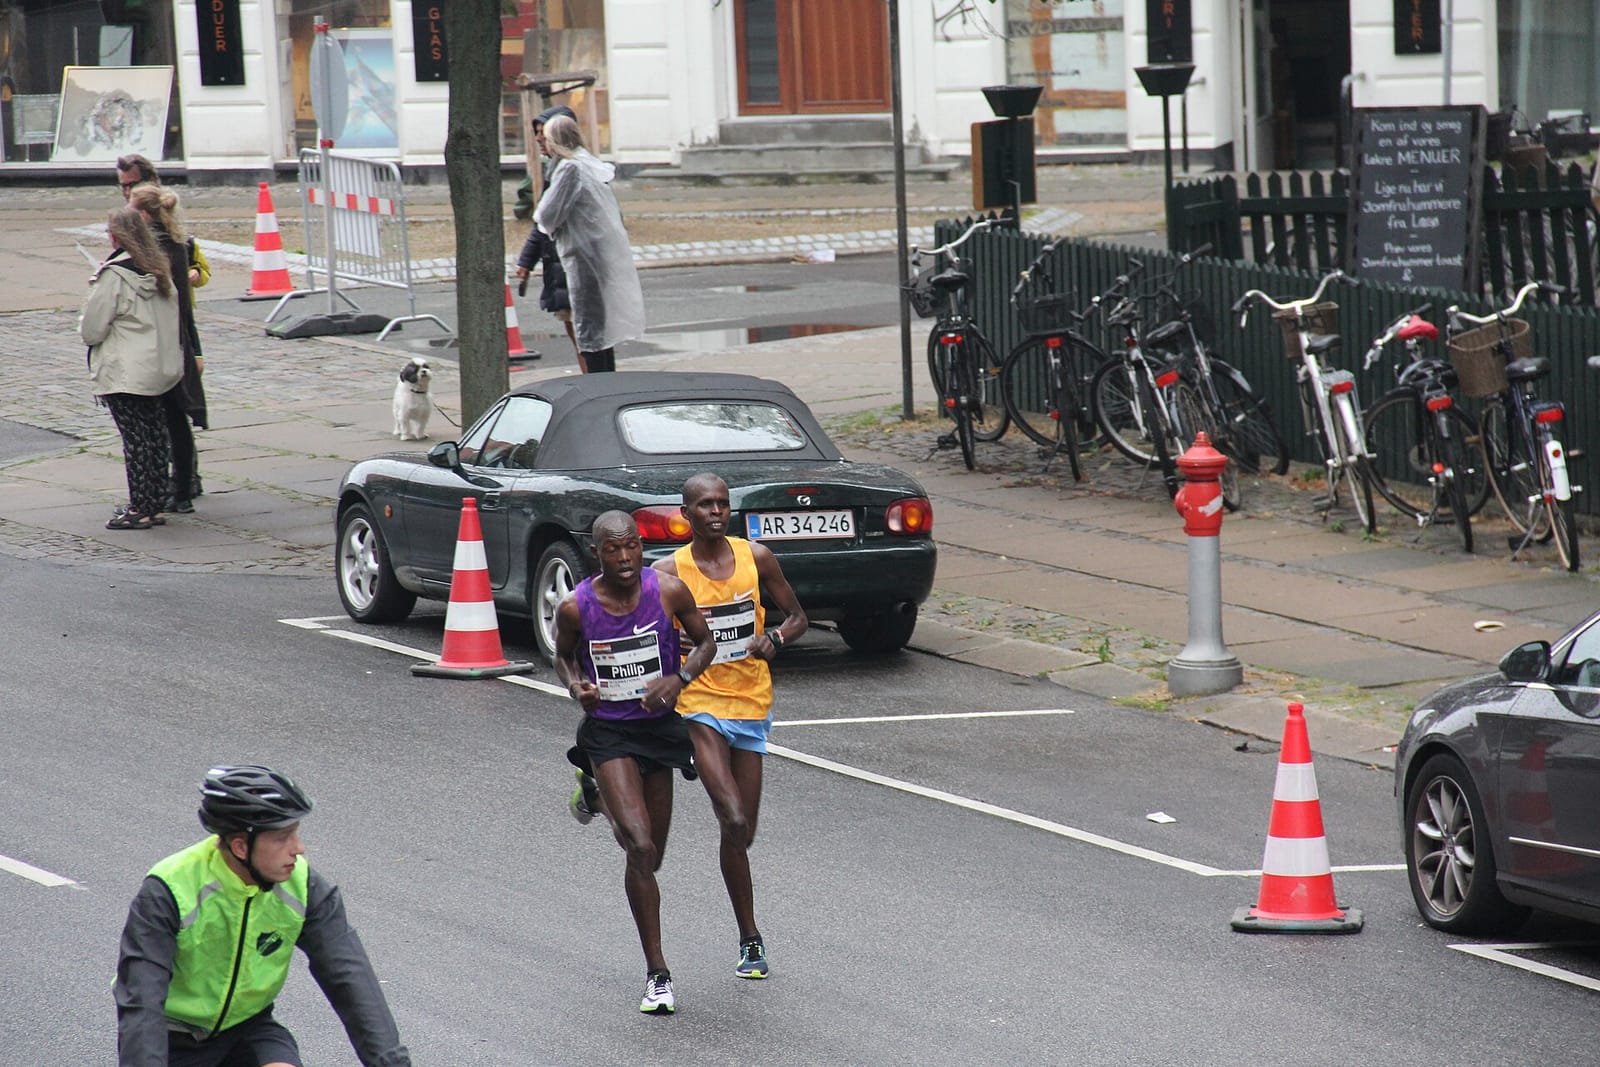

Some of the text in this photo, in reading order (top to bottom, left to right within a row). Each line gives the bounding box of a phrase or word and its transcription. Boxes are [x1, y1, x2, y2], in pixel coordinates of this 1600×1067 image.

[428, 7, 442, 60] GLAS
[1371, 120, 1395, 132] Kom
[1399, 120, 1417, 131] ind
[1421, 121, 1432, 134] og
[1378, 134, 1440, 147] en af vores
[1398, 148, 1460, 165] MENUER
[1375, 179, 1443, 198] Lige nu har vi
[1387, 214, 1407, 230] fra
[763, 514, 850, 535] AR 34 246
[712, 627, 738, 642] Paul
[611, 663, 645, 679] Philip
